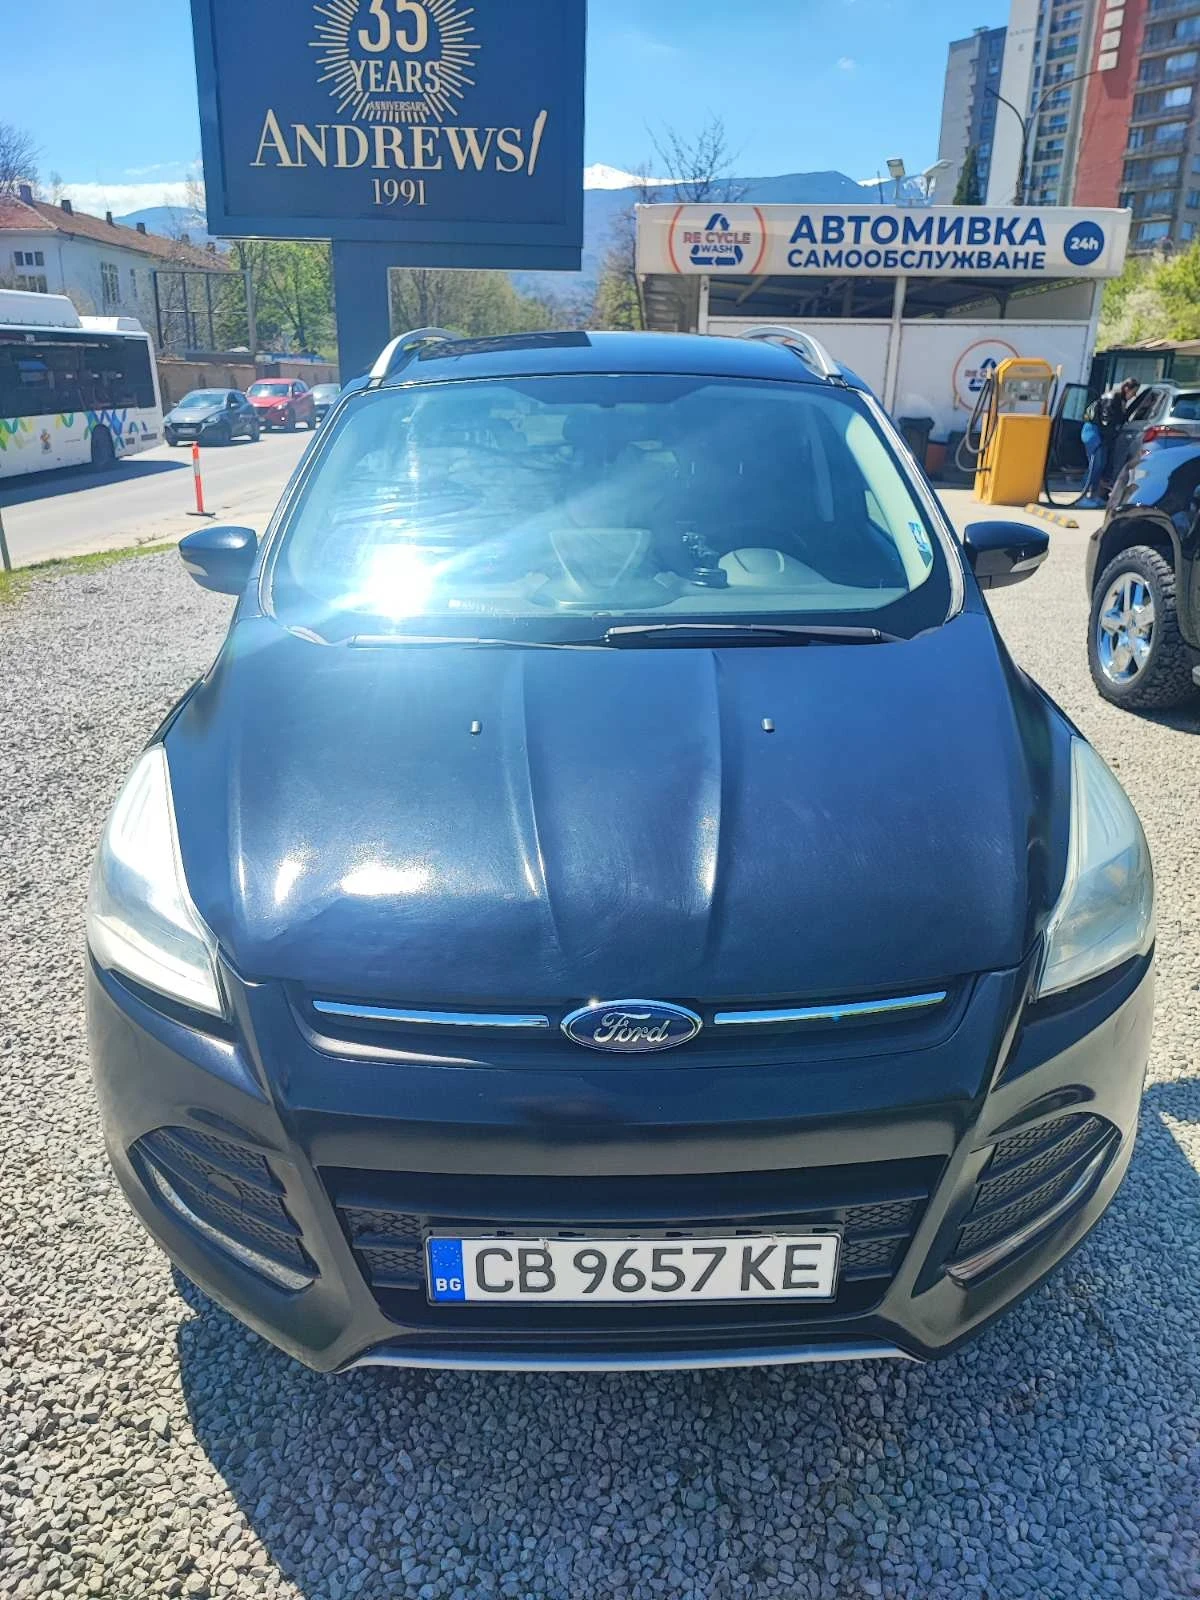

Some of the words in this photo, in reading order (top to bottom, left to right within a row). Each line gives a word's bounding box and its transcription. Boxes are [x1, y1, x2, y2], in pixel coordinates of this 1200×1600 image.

[349, 60, 441, 94] YEARS
[370, 178, 429, 206] 1991
[682, 231, 702, 244] RE
[705, 231, 752, 245] CYCLE
[789, 214, 1047, 247] АВТОМИВКА
[701, 244, 733, 253] WASH
[1069, 235, 1100, 252] 24h
[787, 248, 1047, 270] САМООБСЛУЖВАНЕ
[593, 1011, 672, 1043] Ford
[572, 1246, 728, 1294] 9657
[435, 1277, 462, 1293] BG
